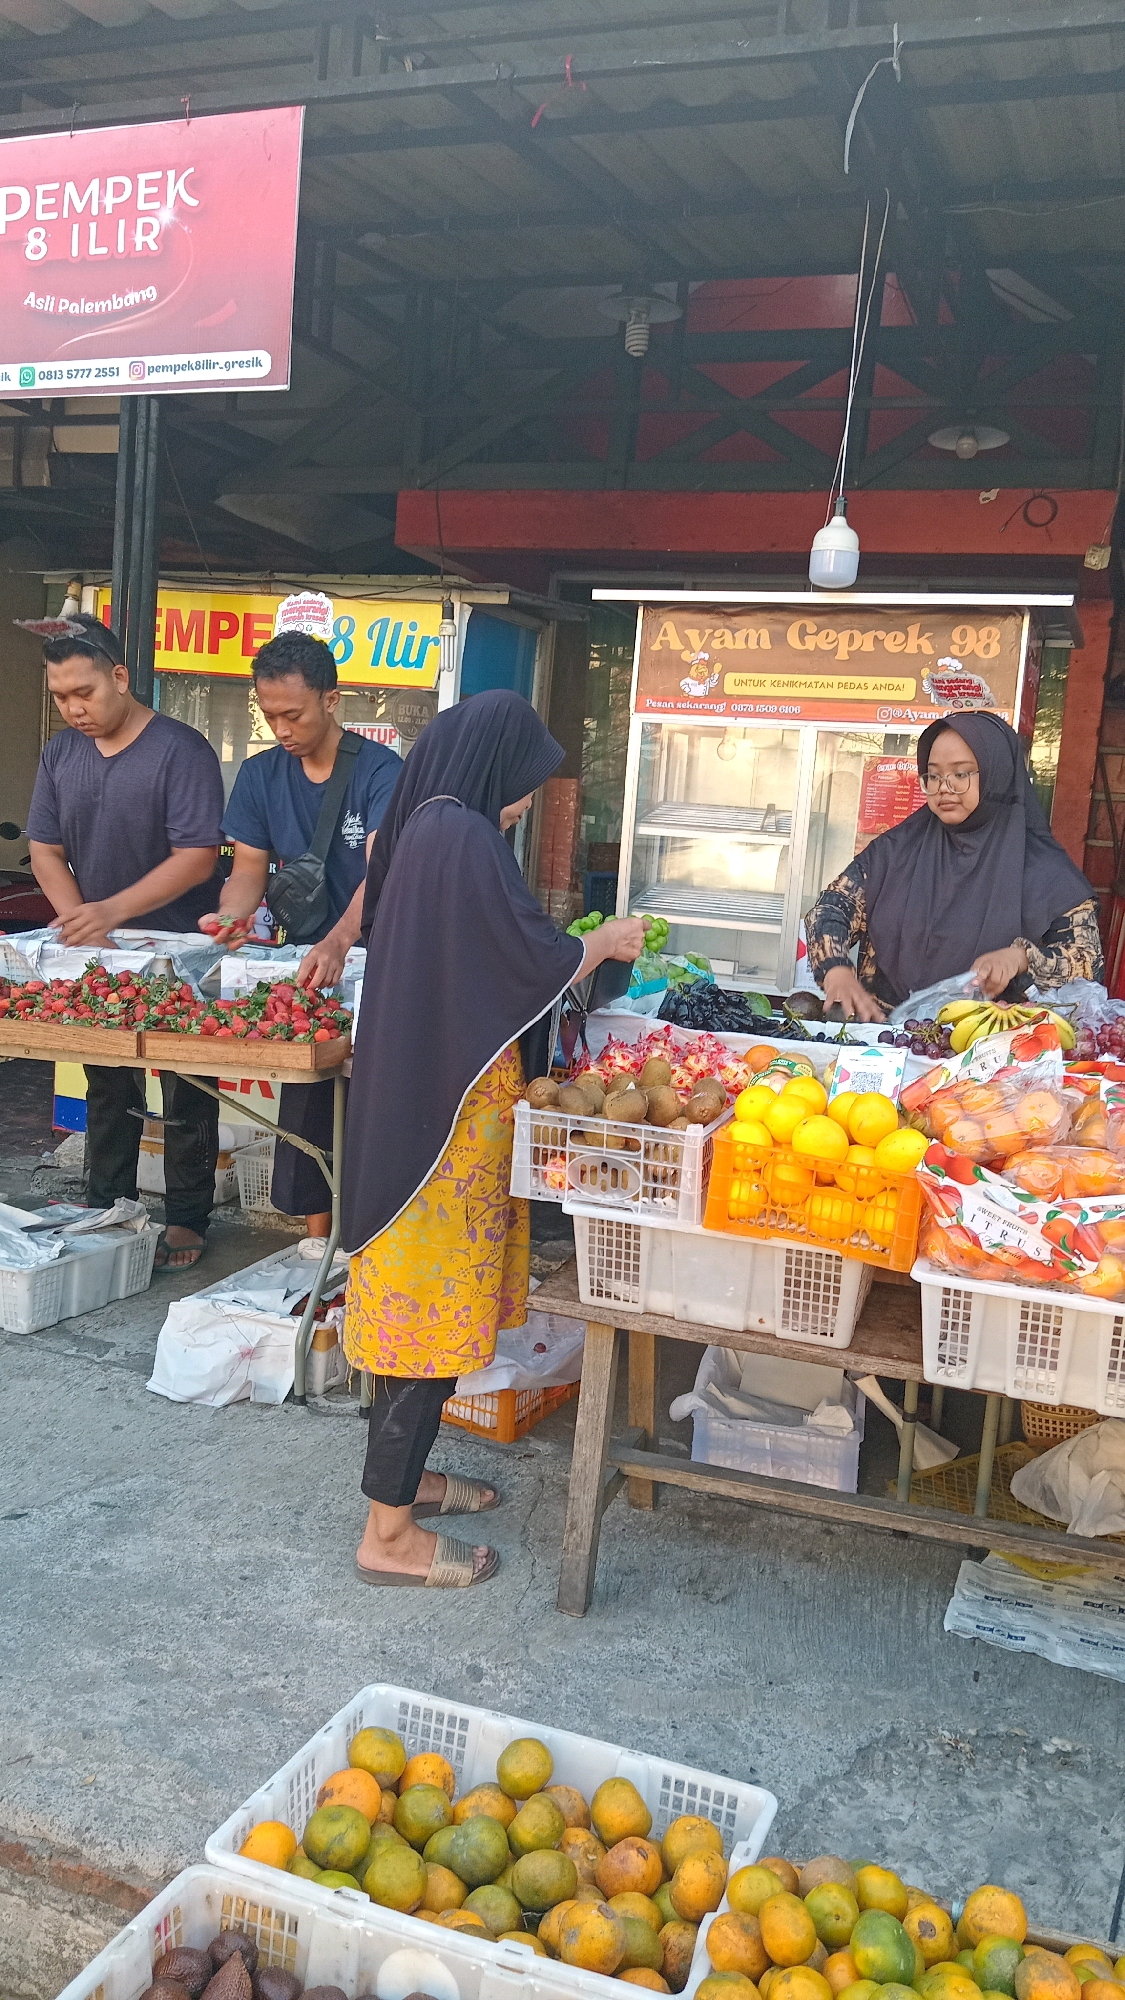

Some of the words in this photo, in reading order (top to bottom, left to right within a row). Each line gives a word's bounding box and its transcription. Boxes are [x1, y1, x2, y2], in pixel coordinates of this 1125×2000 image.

[0, 167, 199, 234] PEMPEK
[24, 227, 48, 260] 8
[70, 217, 161, 257] ILIR
[23, 292, 55, 312] Asli
[57, 286, 158, 314] Palembang
[38, 370, 64, 381] 0813
[66, 368, 92, 380] 5777
[94, 366, 120, 378] 2551
[328, 615, 356, 665] 8
[650, 620, 773, 664] Ayam
[786, 619, 935, 661] Geprek
[950, 624, 1001, 659] 98
[733, 679, 767, 688] UNTUK
[770, 680, 834, 689] KENIKMATAN
[837, 682, 869, 691] PEDAS
[872, 683, 905, 691] ANDA!
[398, 704, 430, 718] BUKA
[645, 699, 675, 708] Pesan
[676, 701, 727, 713] sekarang!
[731, 703, 754, 712] 0878
[779, 705, 801, 714] 6106
[976, 1206, 1001, 1223] SWEET
